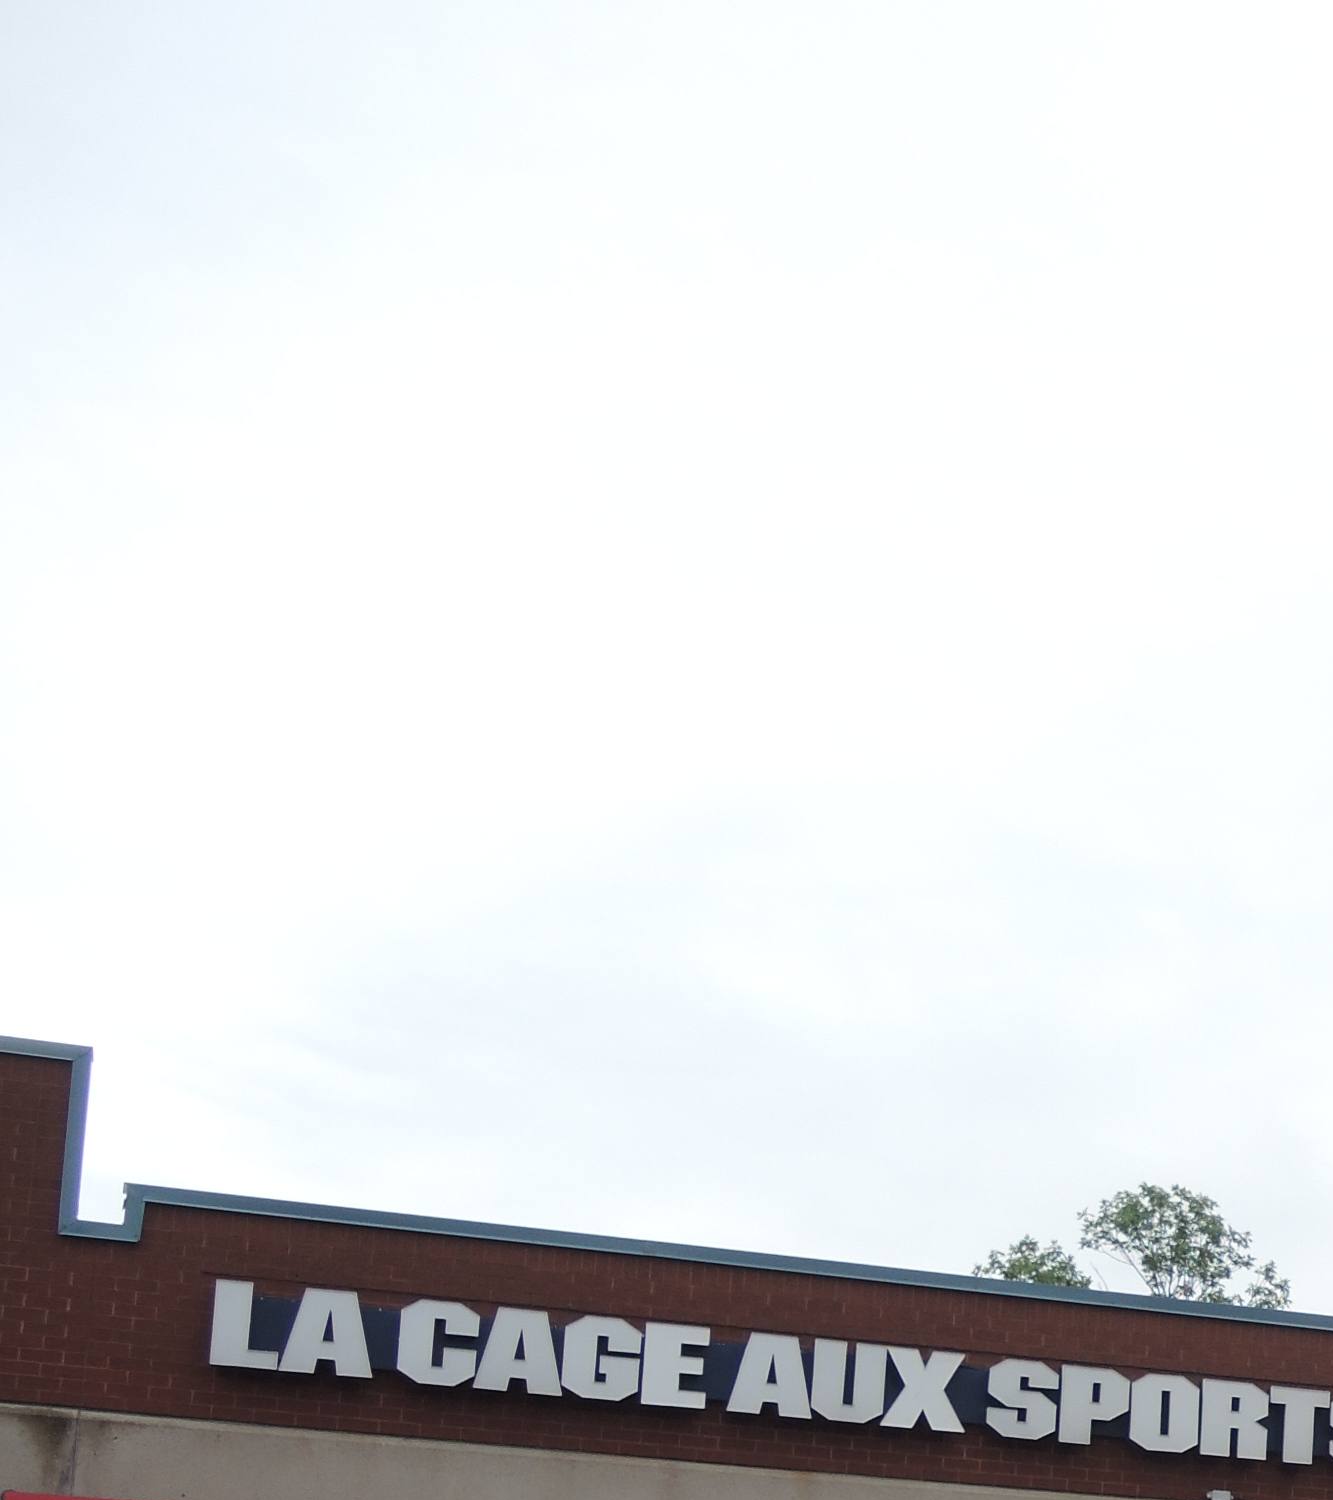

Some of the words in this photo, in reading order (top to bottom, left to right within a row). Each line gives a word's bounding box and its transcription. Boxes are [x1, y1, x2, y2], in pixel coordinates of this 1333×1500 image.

[208, 1278, 373, 1380] LA
[396, 1297, 712, 1410] CAGE
[726, 1331, 967, 1434] AUX
